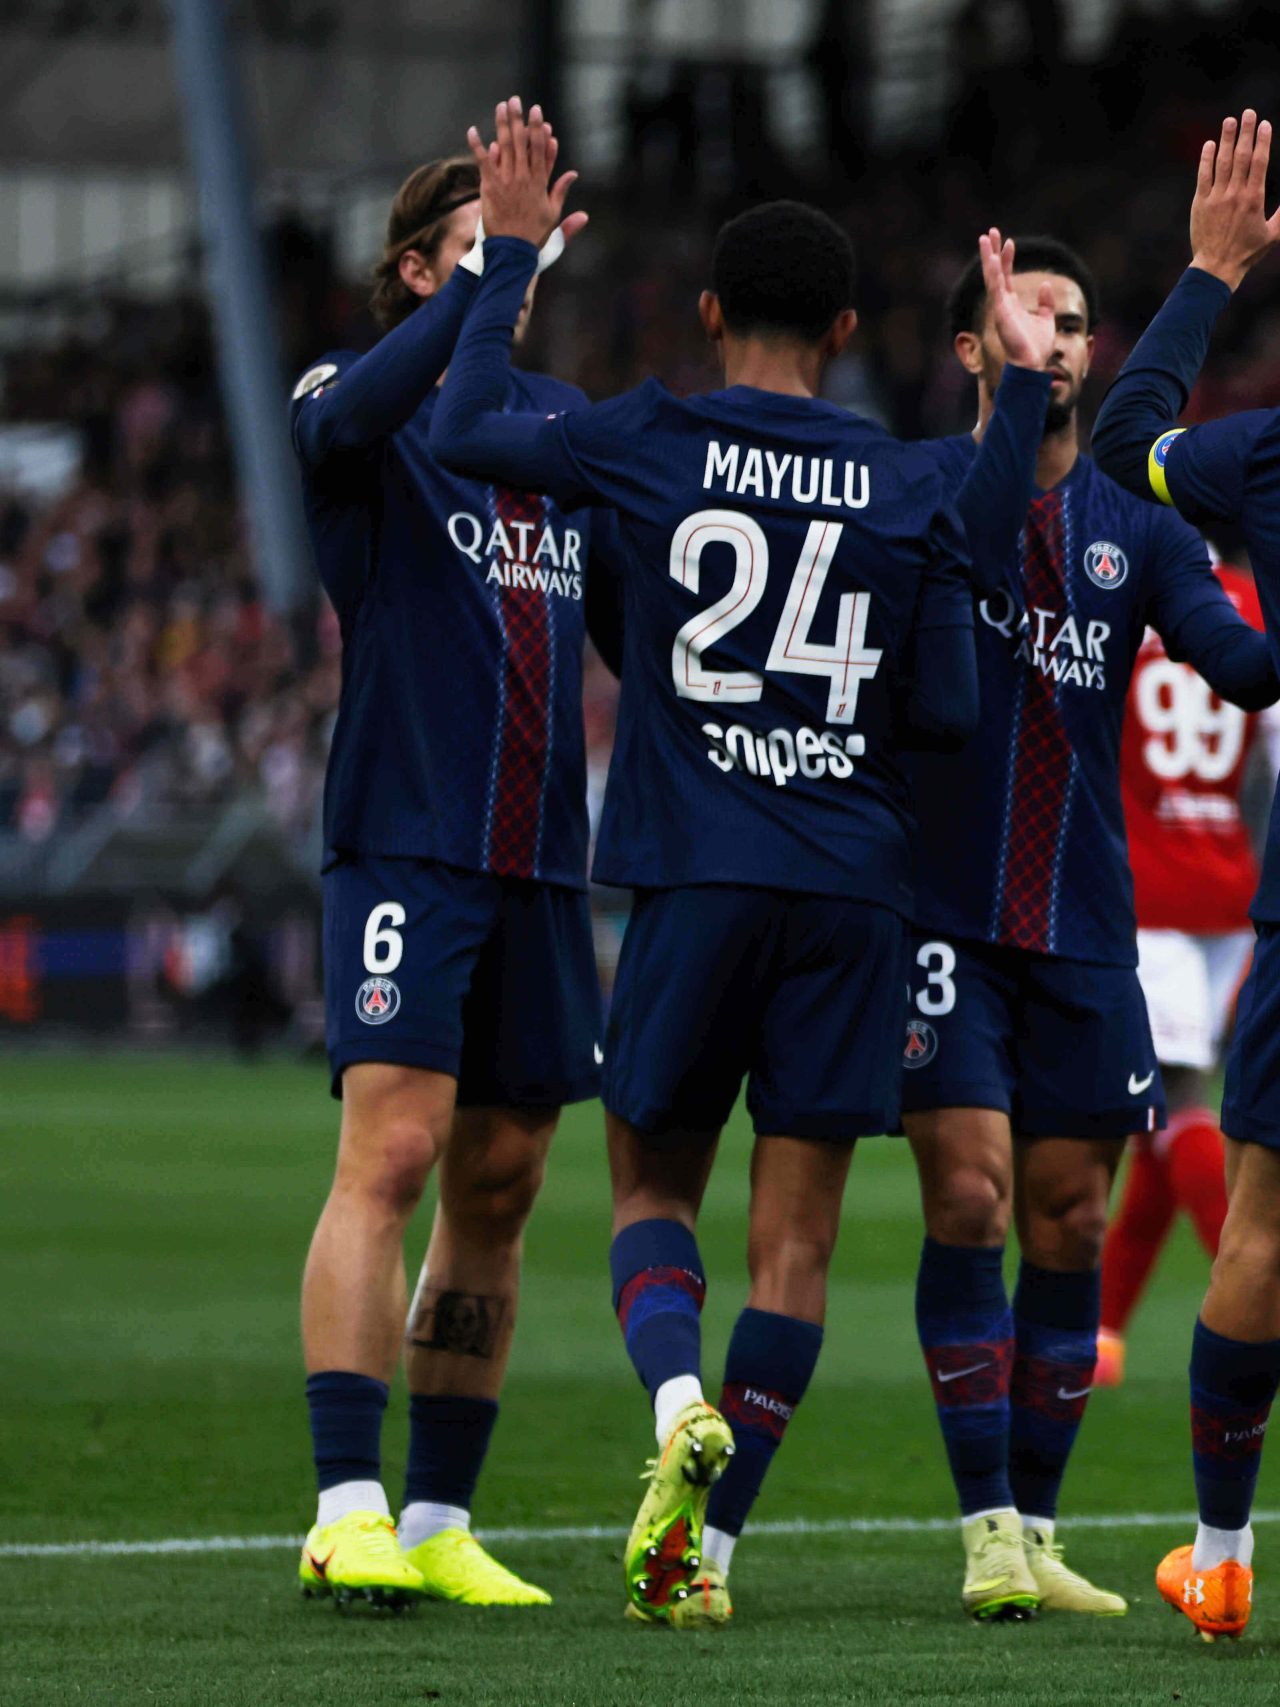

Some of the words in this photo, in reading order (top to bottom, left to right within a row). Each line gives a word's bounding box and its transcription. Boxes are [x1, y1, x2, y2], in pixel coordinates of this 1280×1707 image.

[703, 440, 870, 509] MAYULU
[447, 511, 582, 572] QATAR
[485, 559, 583, 601] AIRWAYS
[669, 508, 883, 725] 24
[1137, 658, 1246, 783] 99
[702, 722, 855, 786] snipes
[363, 901, 406, 974] 6
[743, 1389, 794, 1420] PARIS
